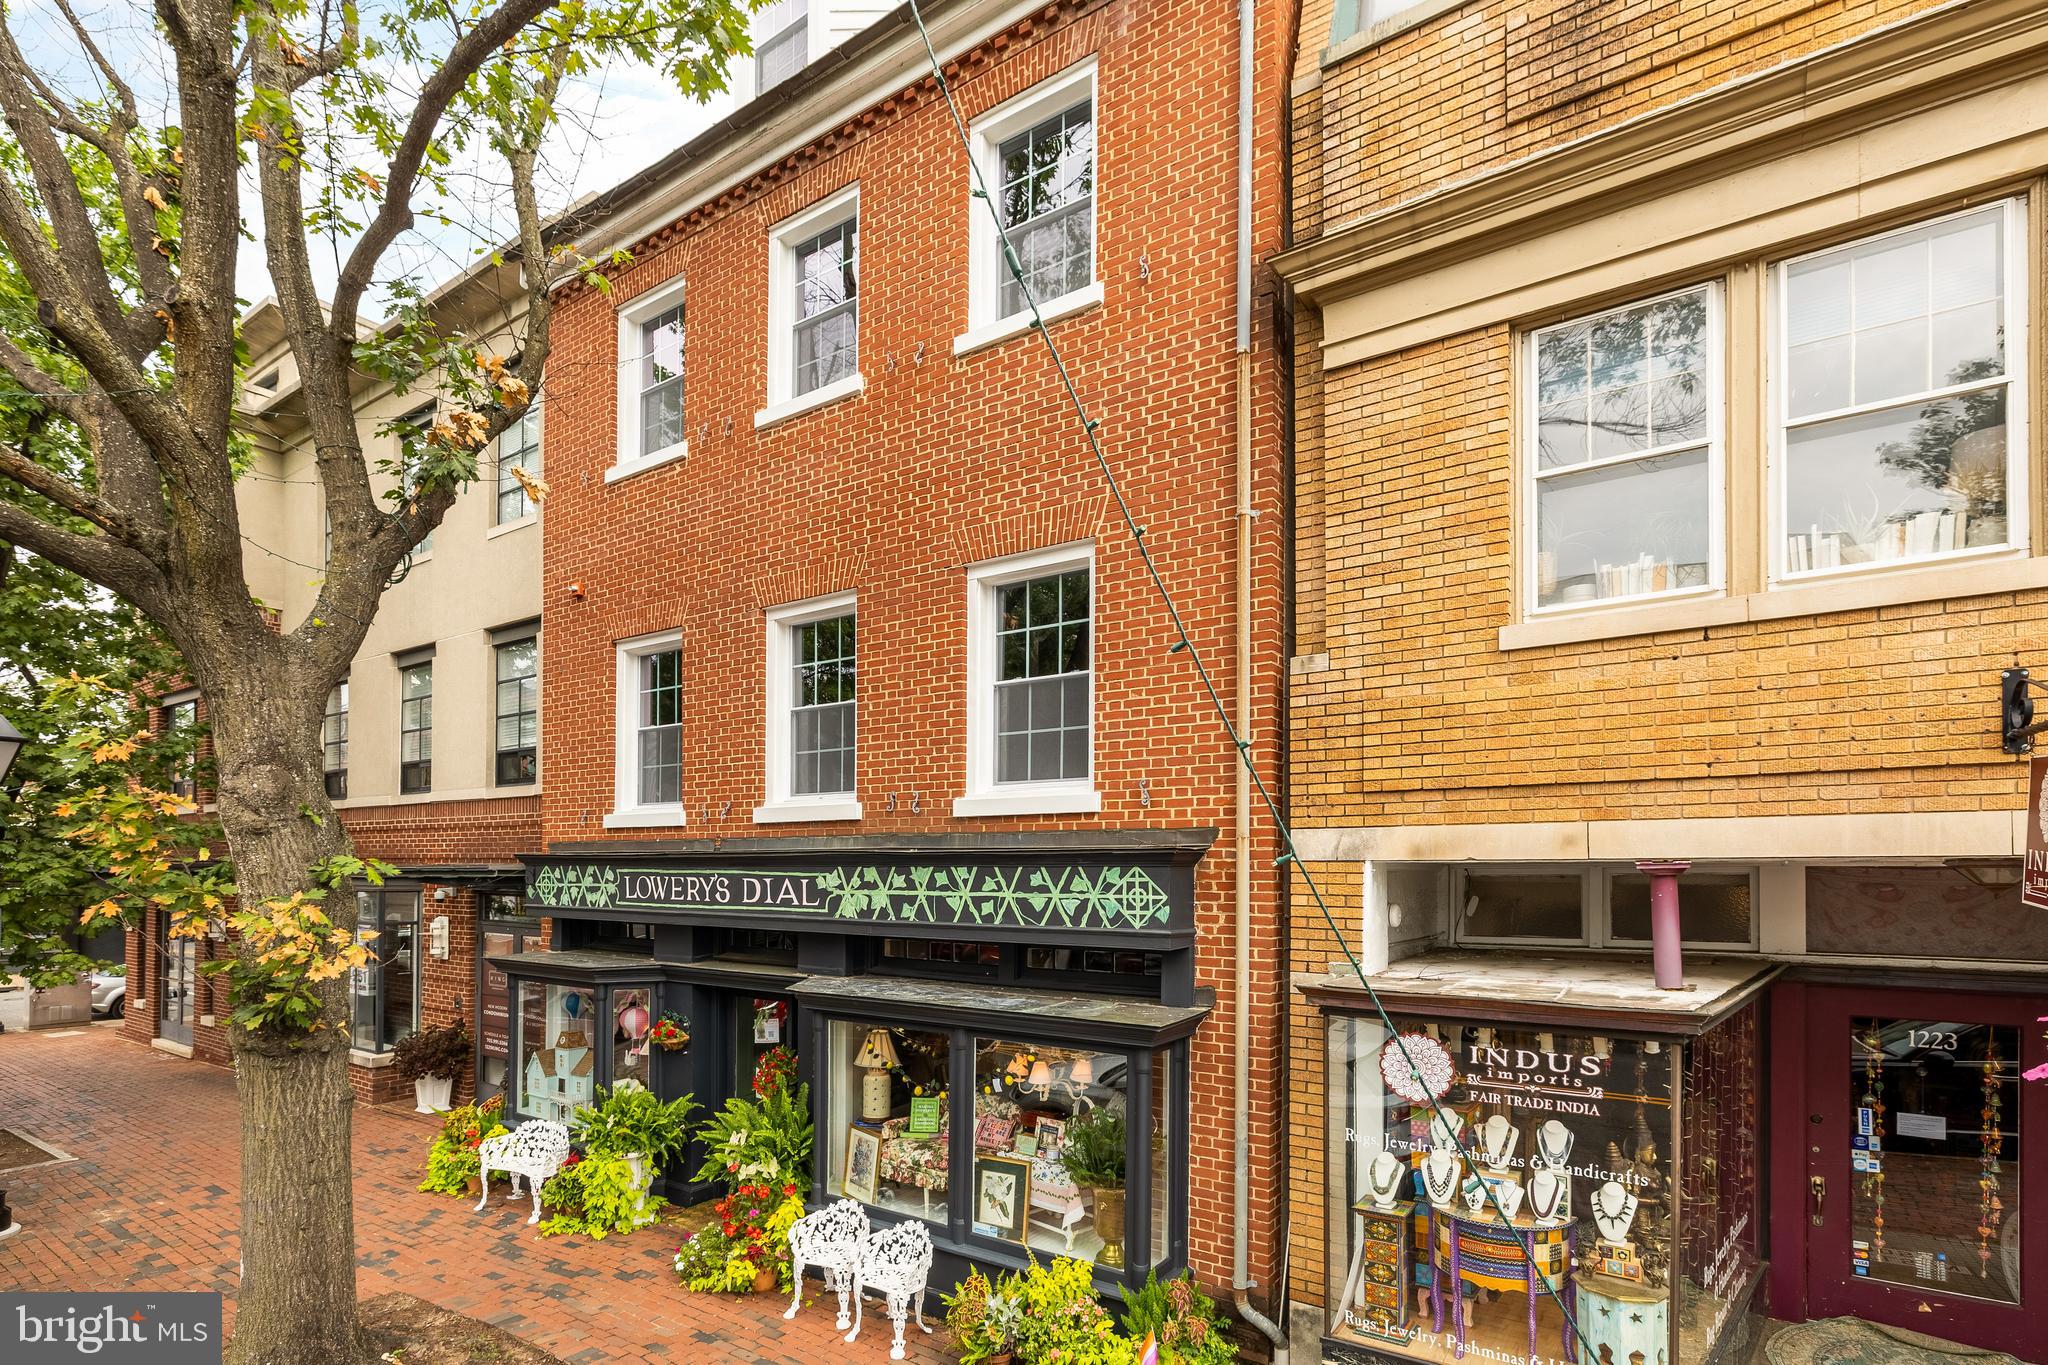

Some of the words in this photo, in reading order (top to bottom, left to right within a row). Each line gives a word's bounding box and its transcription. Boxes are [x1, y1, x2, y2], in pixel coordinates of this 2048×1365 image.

[624, 873, 731, 904] LOWERY'S
[742, 877, 820, 906] DIAL
[1908, 1030, 1958, 1050] 1223
[1469, 1045, 1601, 1076] INDUS
[1487, 1067, 1583, 1087] imports
[1470, 1090, 1501, 1104] FAIR
[1504, 1094, 1553, 1111] TRADE
[1556, 1100, 1601, 1117] INDIA
[1530, 1154, 1543, 1170] &
[1446, 1334, 1525, 1365] Pashminas
